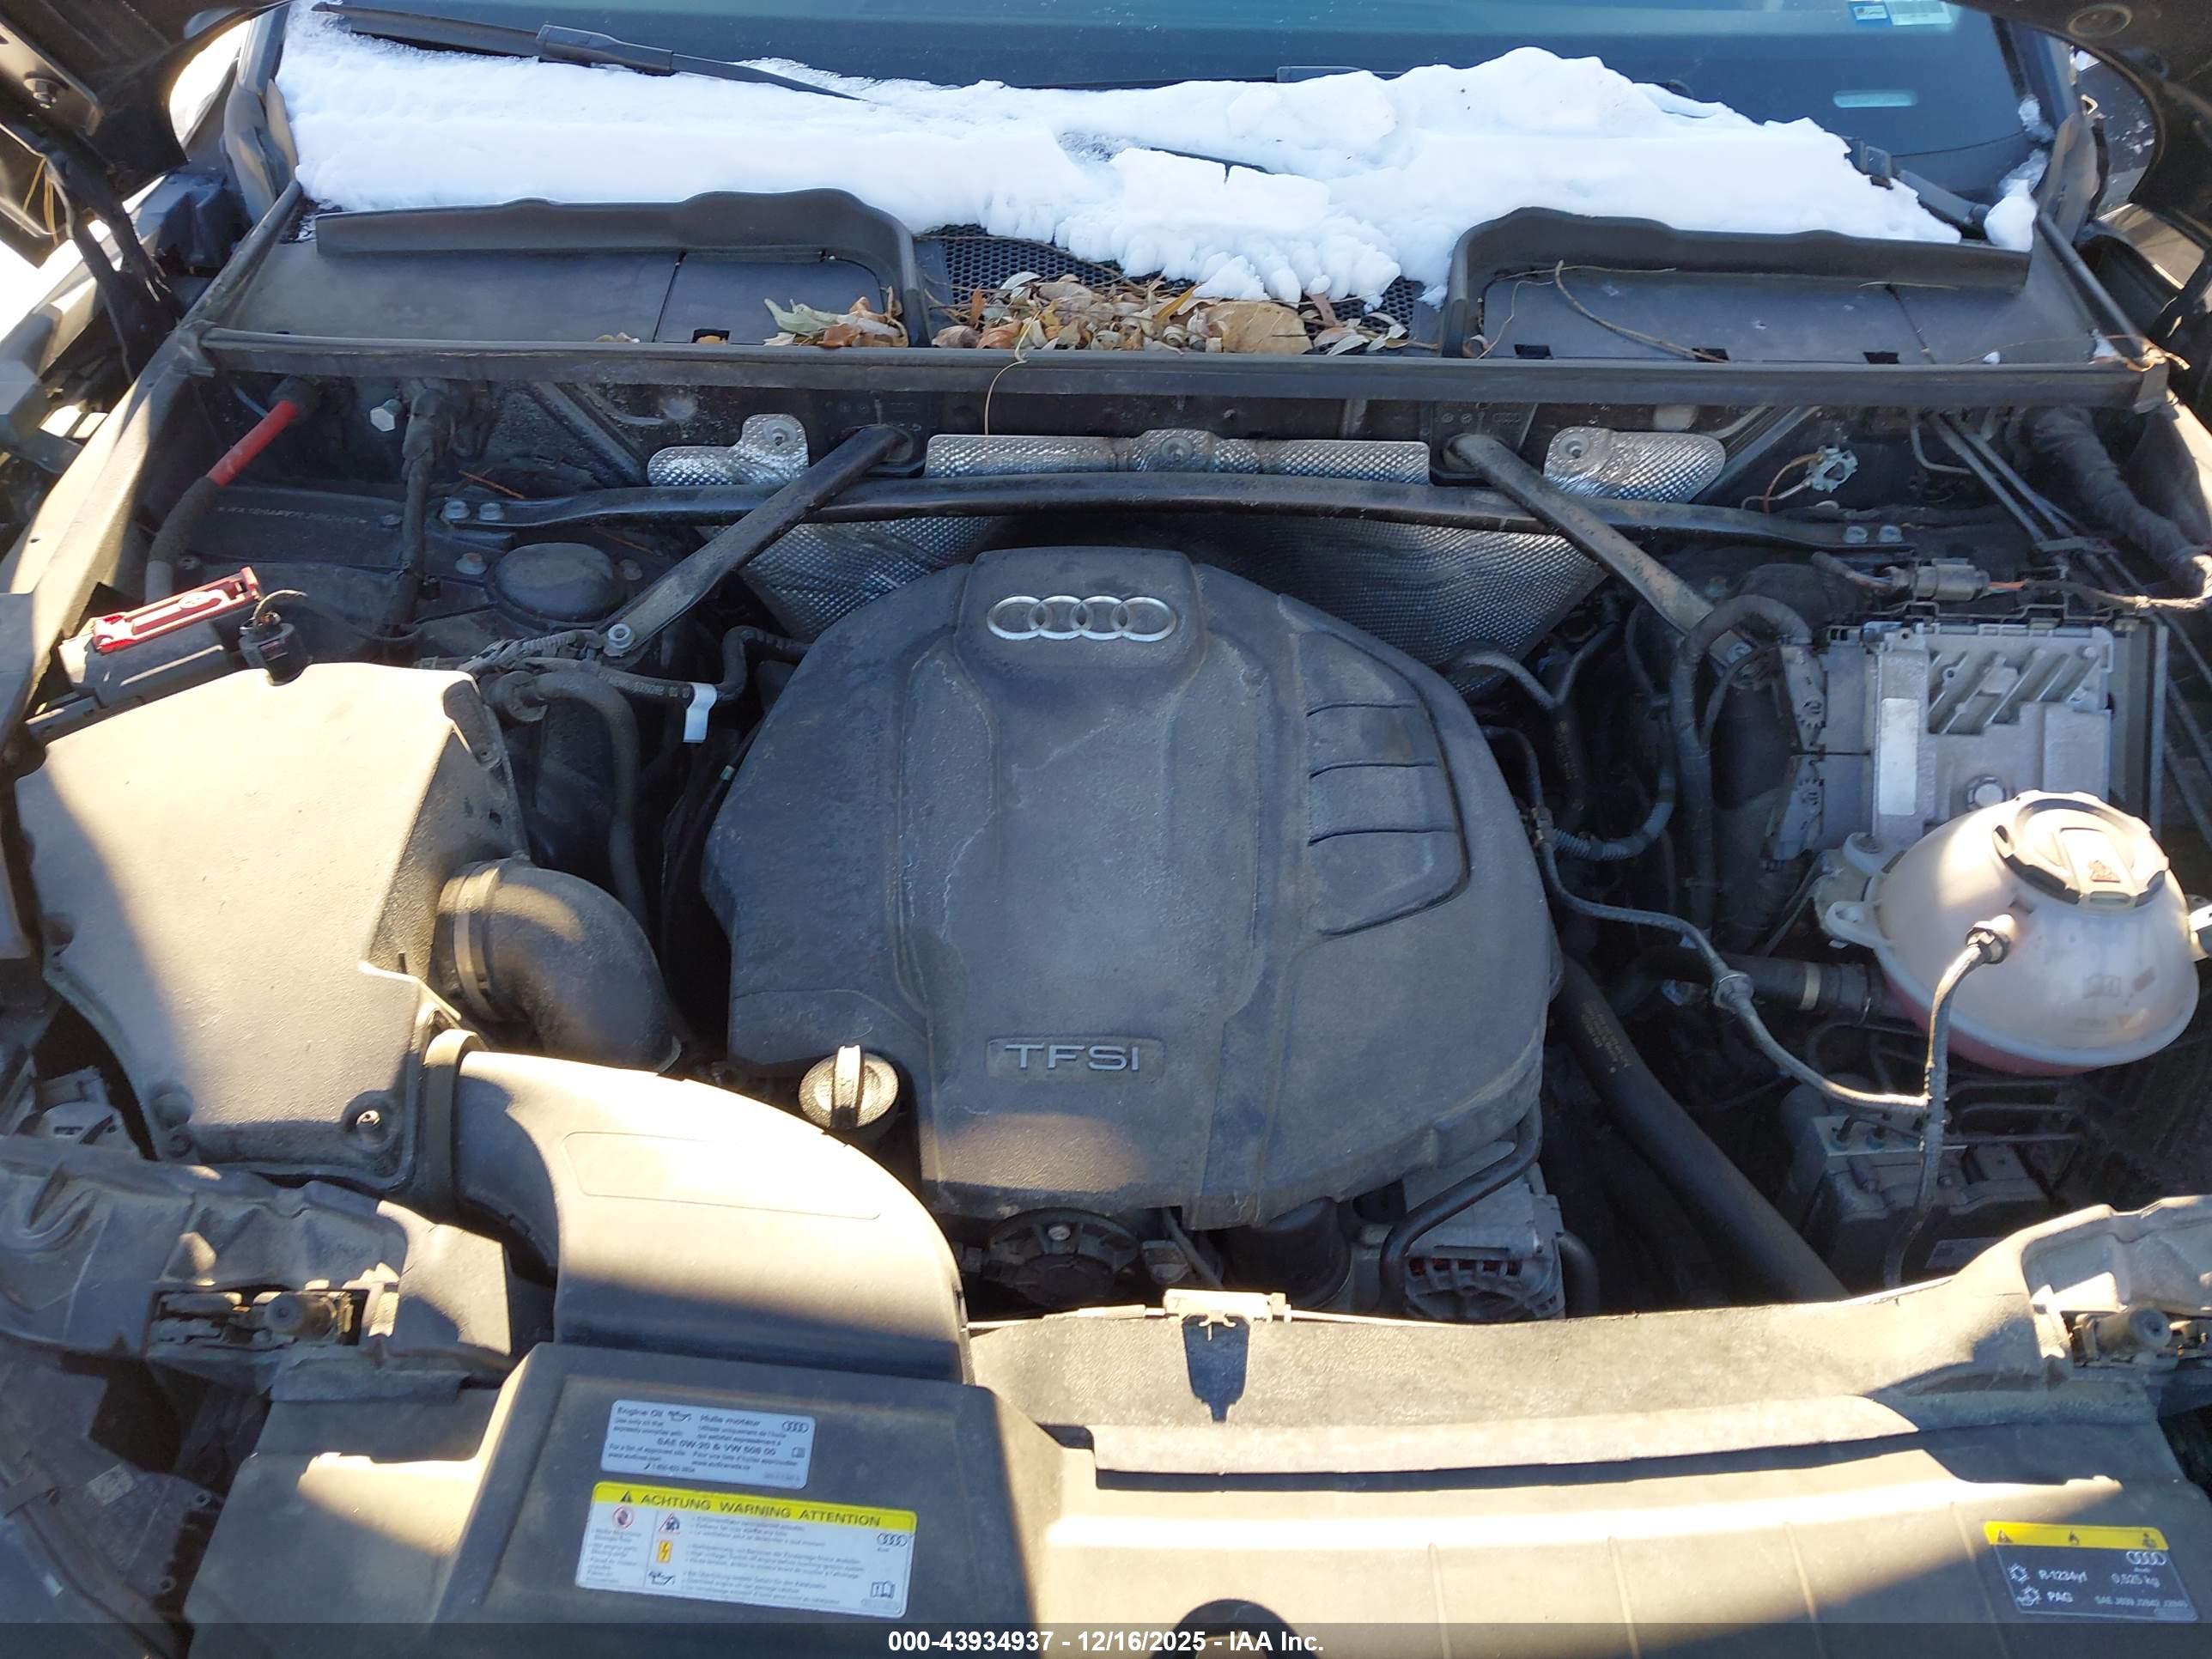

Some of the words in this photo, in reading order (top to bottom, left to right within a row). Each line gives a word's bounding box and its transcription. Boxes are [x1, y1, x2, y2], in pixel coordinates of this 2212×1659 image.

[1004, 1042, 1139, 1072] TFSI
[641, 1493, 711, 1511] ACHTUNG
[720, 1501, 792, 1519] WARNING
[799, 1510, 880, 1527] ATTENTION
[2047, 1591, 2074, 1603] PAG
